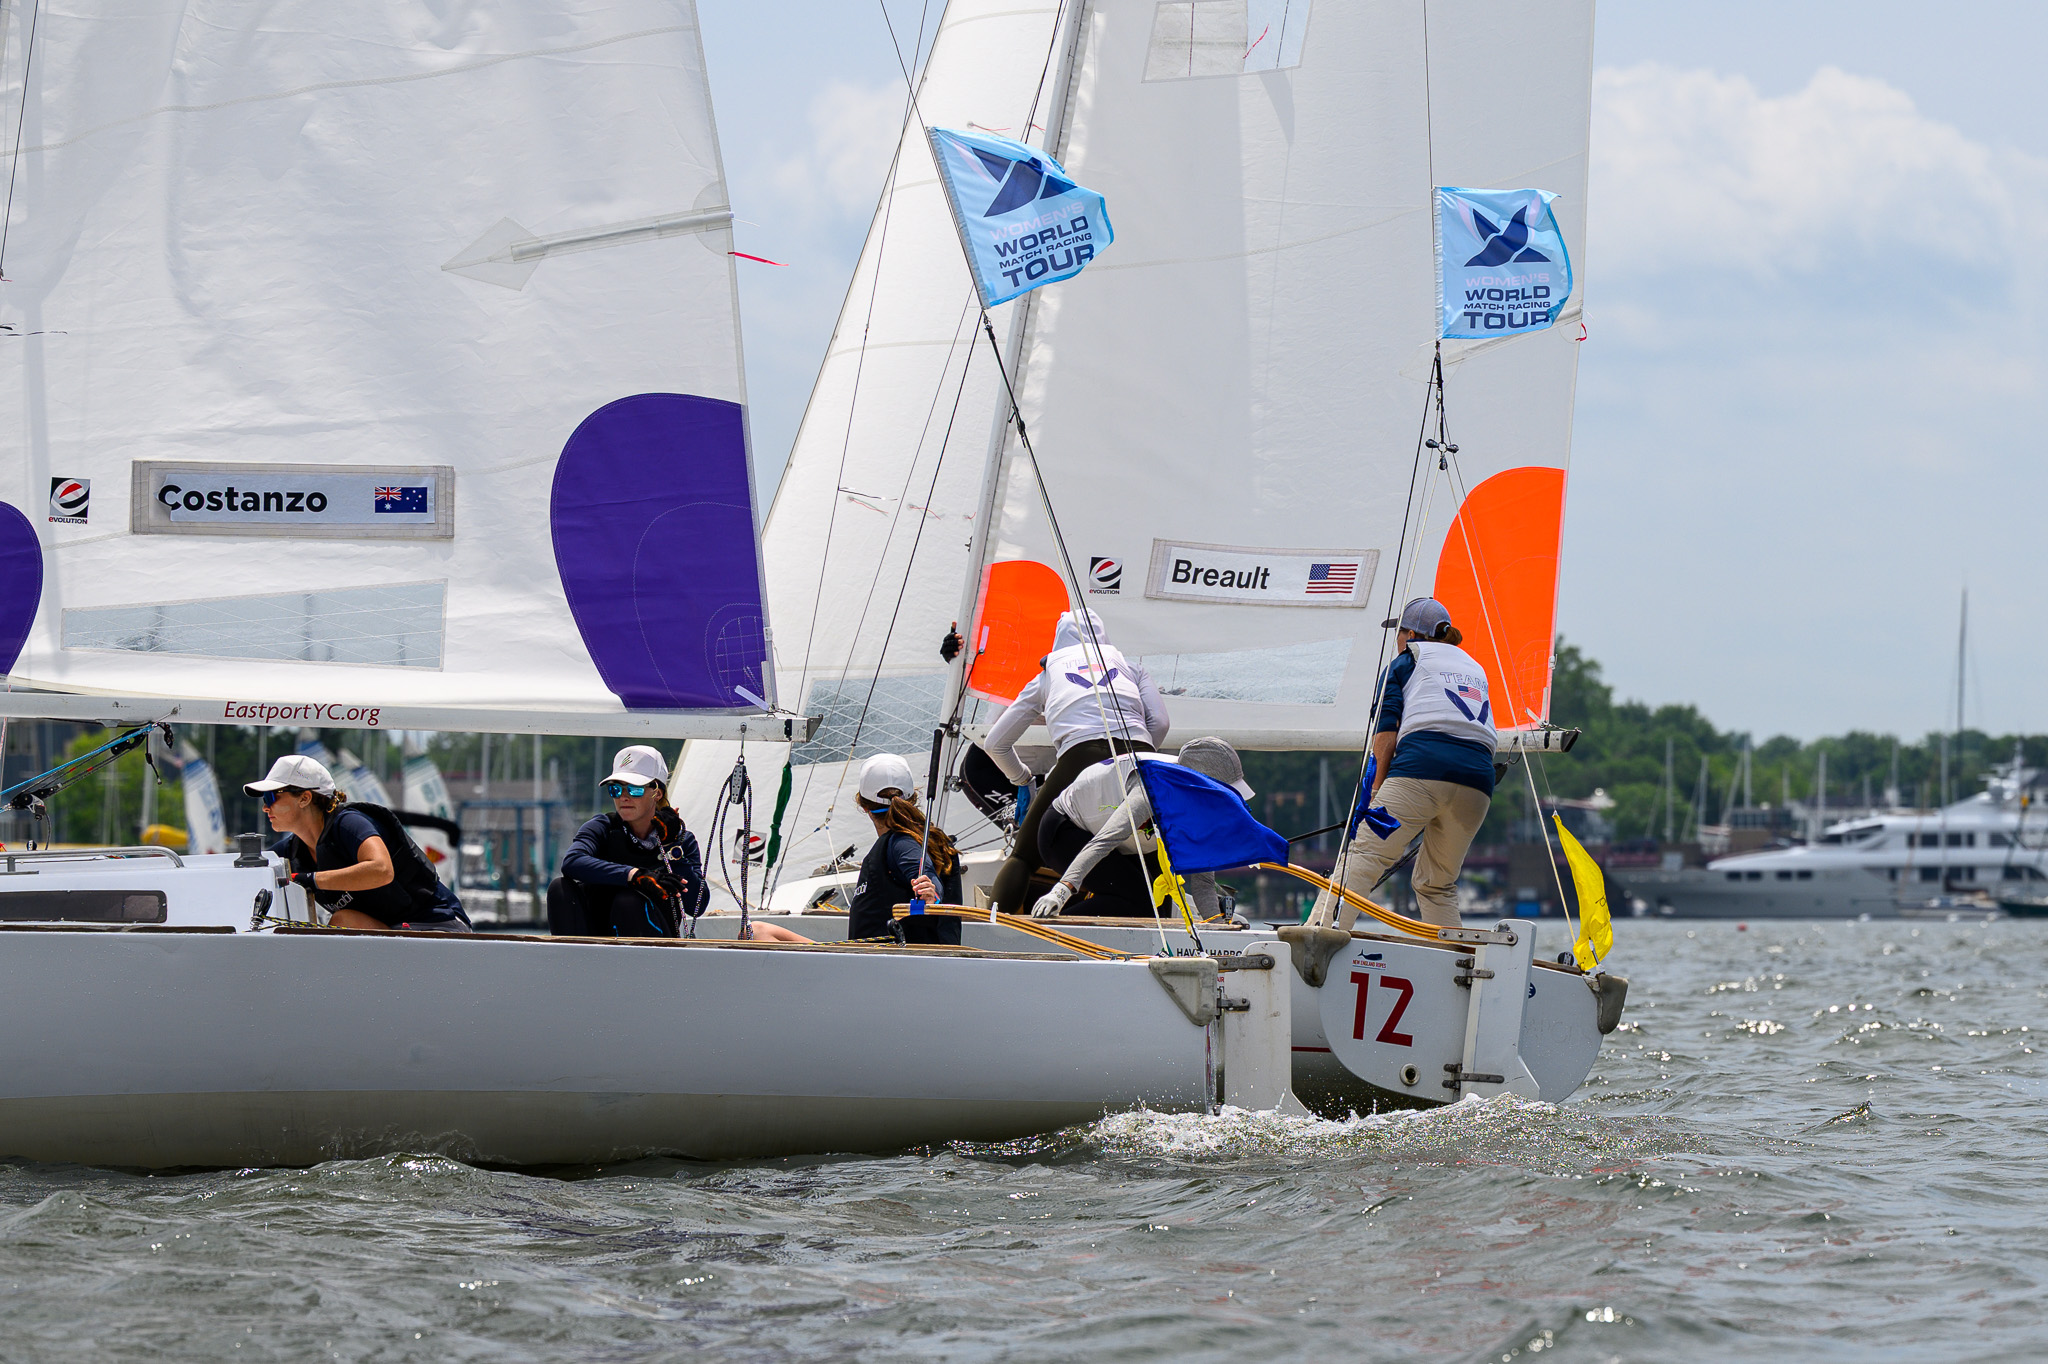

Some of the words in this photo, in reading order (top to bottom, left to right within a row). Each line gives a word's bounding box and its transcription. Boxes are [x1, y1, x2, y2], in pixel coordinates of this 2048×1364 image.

[990, 201, 1085, 240] WOMEN'S
[993, 215, 1089, 258] WORLD
[999, 248, 1043, 269] MATCH
[1046, 232, 1092, 252] RACING
[1002, 243, 1095, 288] TOUR
[1465, 273, 1550, 288] WOMEN'S
[1463, 302, 1505, 311] MATCH
[1507, 301, 1551, 310] RACING
[1465, 285, 1550, 301] WORLD
[1463, 311, 1550, 330] TOUR
[158, 484, 328, 514] Costanzo
[1171, 558, 1270, 590] Breault
[224, 701, 381, 726] EastportYC.org
[1350, 971, 1414, 1047] 12
